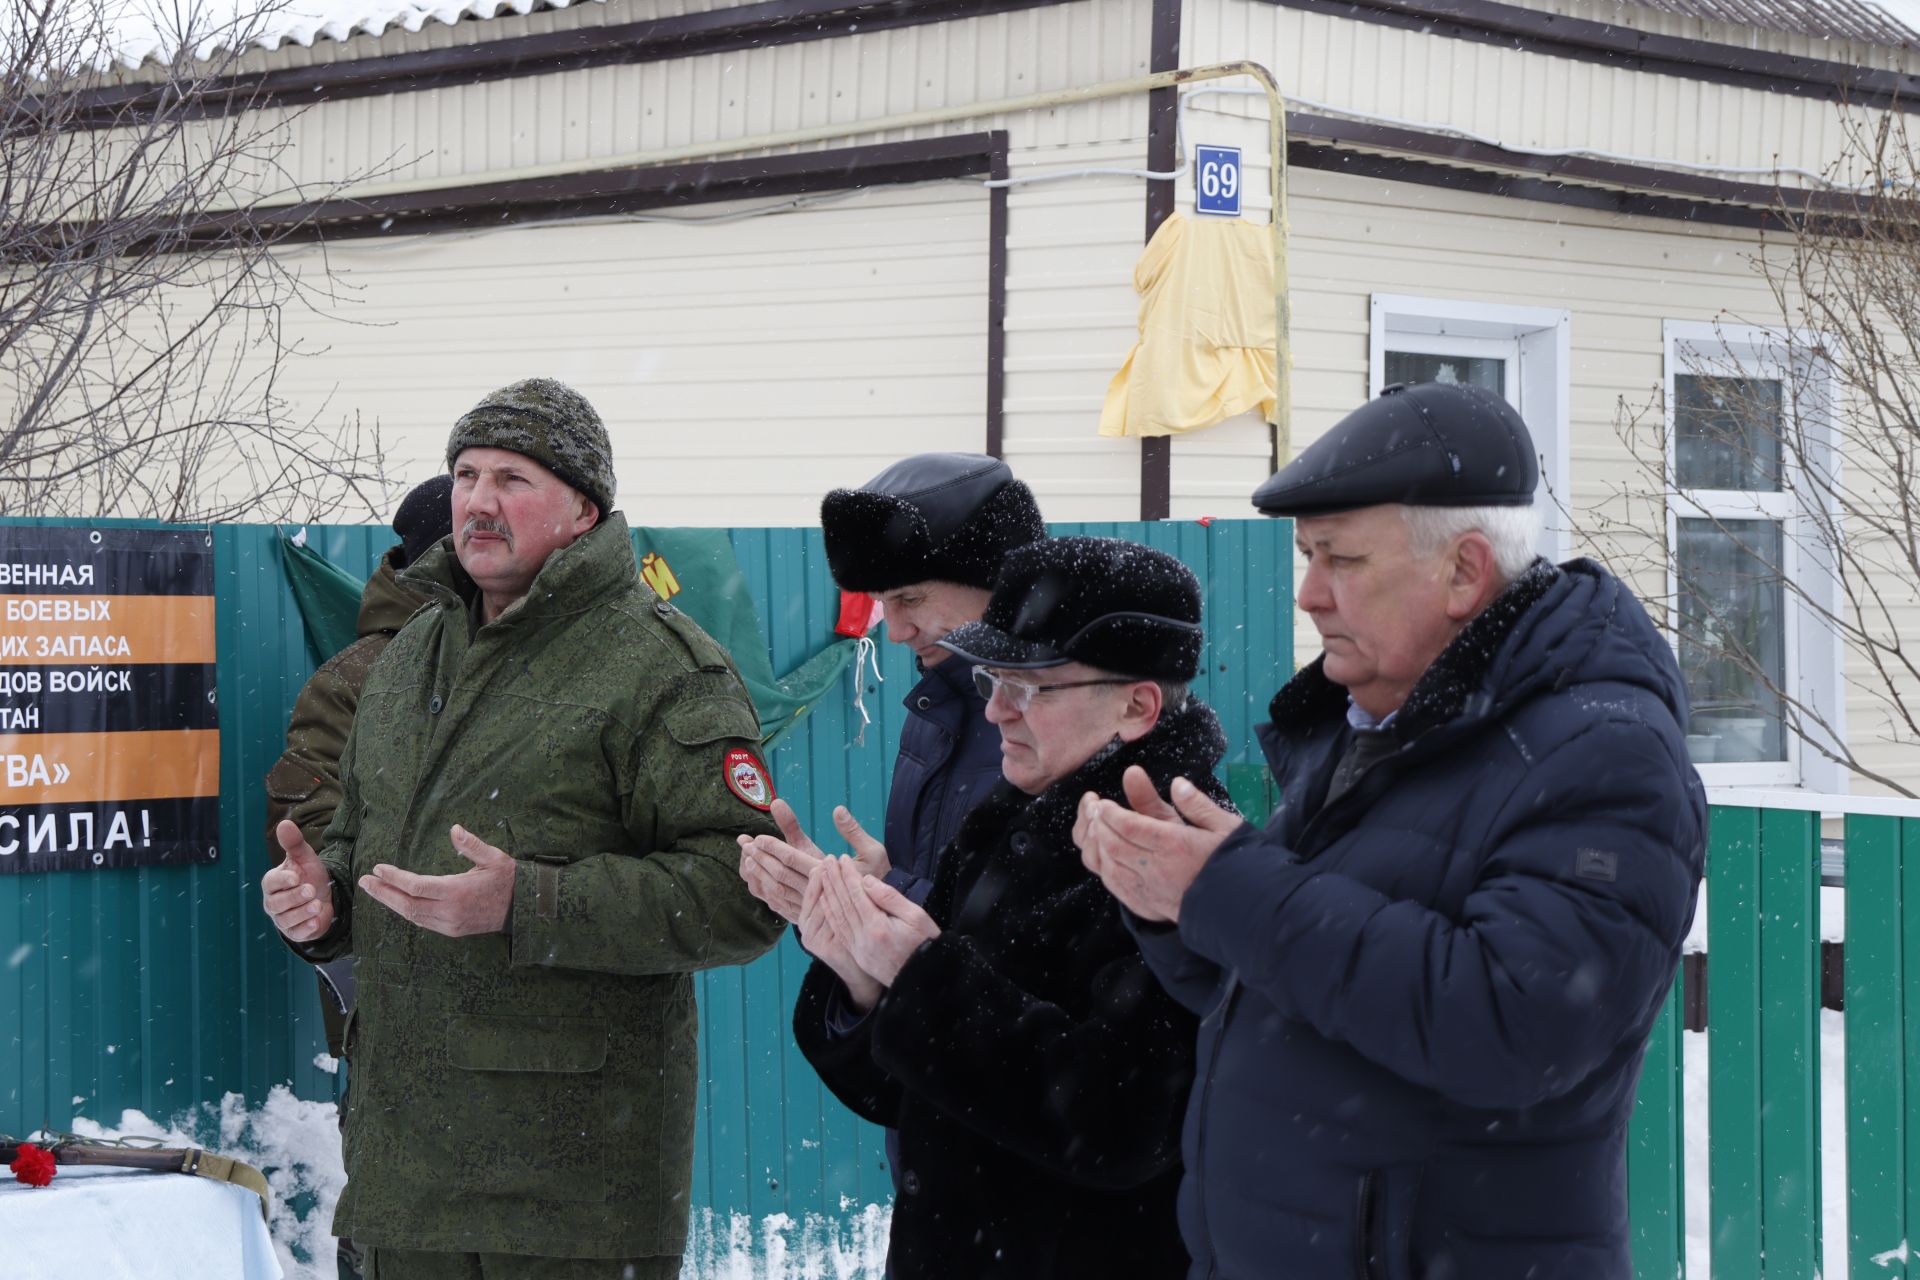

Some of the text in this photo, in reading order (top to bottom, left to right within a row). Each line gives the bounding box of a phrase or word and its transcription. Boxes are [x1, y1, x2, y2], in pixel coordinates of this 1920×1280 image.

[1202, 161, 1238, 198] 69
[0, 563, 94, 586] ВЕННАЯ
[639, 551, 682, 602] Й
[6, 600, 111, 622] БОЕВЫХ
[0, 636, 131, 660] ИХ ЗАПАСА
[0, 666, 132, 697] ДОВ ВОЙСК
[0, 707, 39, 729] ТАН
[0, 753, 71, 787] ВА»
[0, 810, 151, 856] СИЛА!
